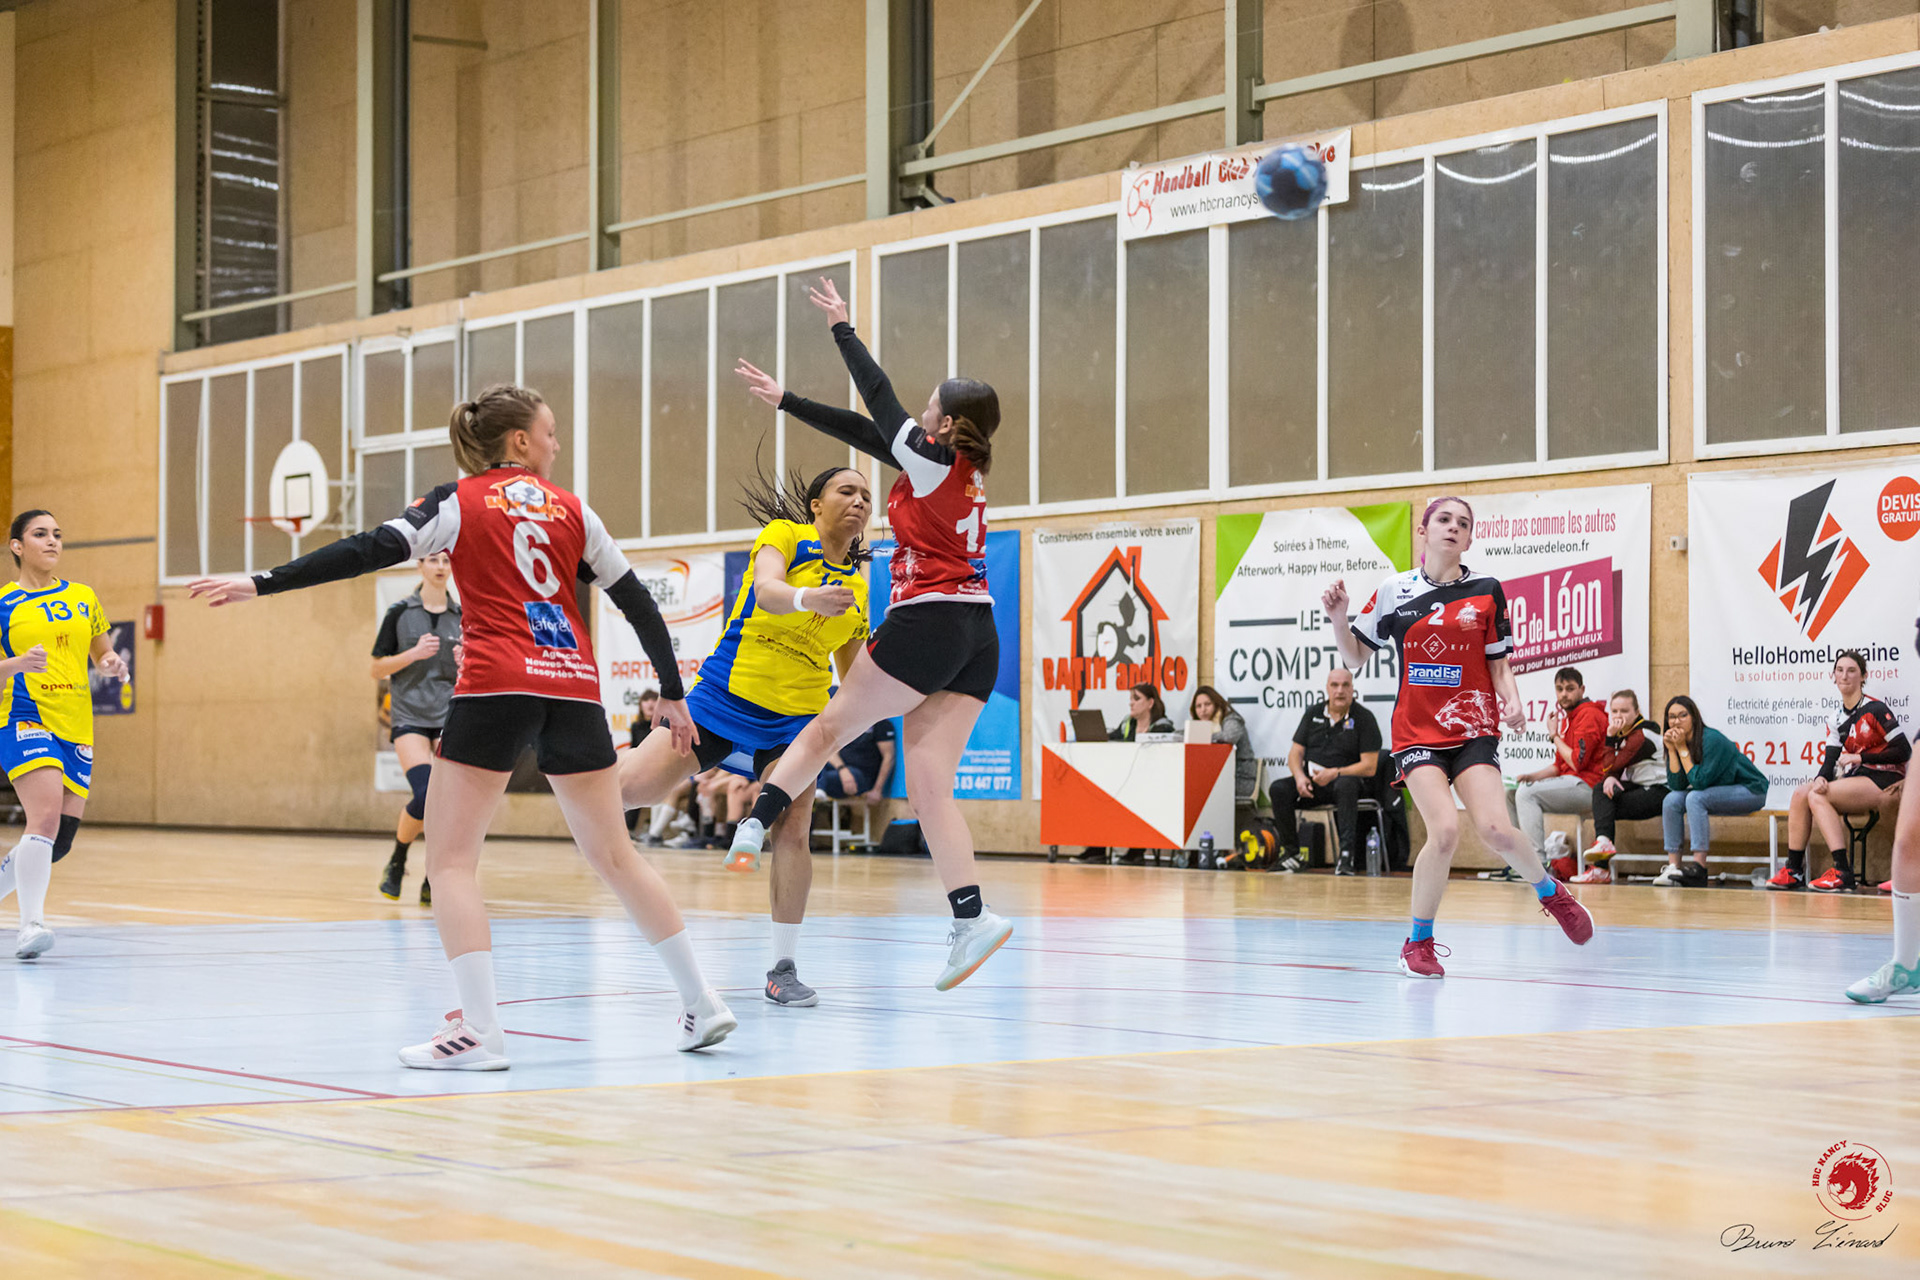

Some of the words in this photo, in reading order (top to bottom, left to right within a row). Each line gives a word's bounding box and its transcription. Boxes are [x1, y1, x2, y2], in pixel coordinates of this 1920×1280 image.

[1153, 162, 1211, 195] Handball
[1218, 157, 1251, 183] Club
[1882, 493, 1920, 511] DEVIS
[956, 506, 988, 554] 1
[1039, 530, 1094, 544] Construisons
[1095, 527, 1137, 540] ensemble
[1140, 526, 1163, 537] votre
[1165, 523, 1194, 536] avenir
[1475, 515, 1509, 539] caviste
[1512, 518, 1528, 540] pas
[1531, 515, 1565, 536] comme
[1568, 509, 1582, 534] les
[1585, 508, 1616, 533] autres
[1273, 539, 1306, 553] Soirées
[1308, 537, 1314, 550] à
[1316, 536, 1350, 551] Thème,
[1485, 539, 1590, 556] www.lacavedeleon.fr
[513, 521, 561, 598] 6
[1237, 563, 1285, 578] Afterwork,
[1287, 561, 1318, 577] Happy
[1320, 560, 1344, 574] Hour,
[36, 600, 73, 622] 13
[1428, 602, 1445, 626] 2
[1529, 612, 1543, 644] de
[1543, 570, 1602, 641] Léon
[1301, 610, 1320, 631] LE
[1507, 643, 1541, 660] PAGNES
[1543, 643, 1549, 653] &
[1552, 631, 1603, 651] SPIRITUEUX
[1229, 645, 1396, 682] COMPTIR
[1526, 659, 1543, 672] pour
[1544, 655, 1556, 667] les
[1557, 648, 1599, 666] particuliers
[1042, 656, 1107, 690] BATIM
[1116, 656, 1154, 690] and
[1162, 656, 1188, 691] CO
[1734, 670, 1745, 682] La
[1748, 668, 1795, 682] solution
[1798, 670, 1824, 683] pour
[1870, 667, 1899, 681] rojet
[1262, 686, 1359, 709] Campae
[1727, 696, 1770, 710] Électricité
[1772, 697, 1813, 713] générale
[1727, 714, 1737, 724] et
[1739, 712, 1788, 725] Rénovation
[1504, 748, 1533, 759] 54000
[1765, 741, 1791, 765] 21
[975, 776, 992, 790] 447
[993, 776, 1012, 790] 077
